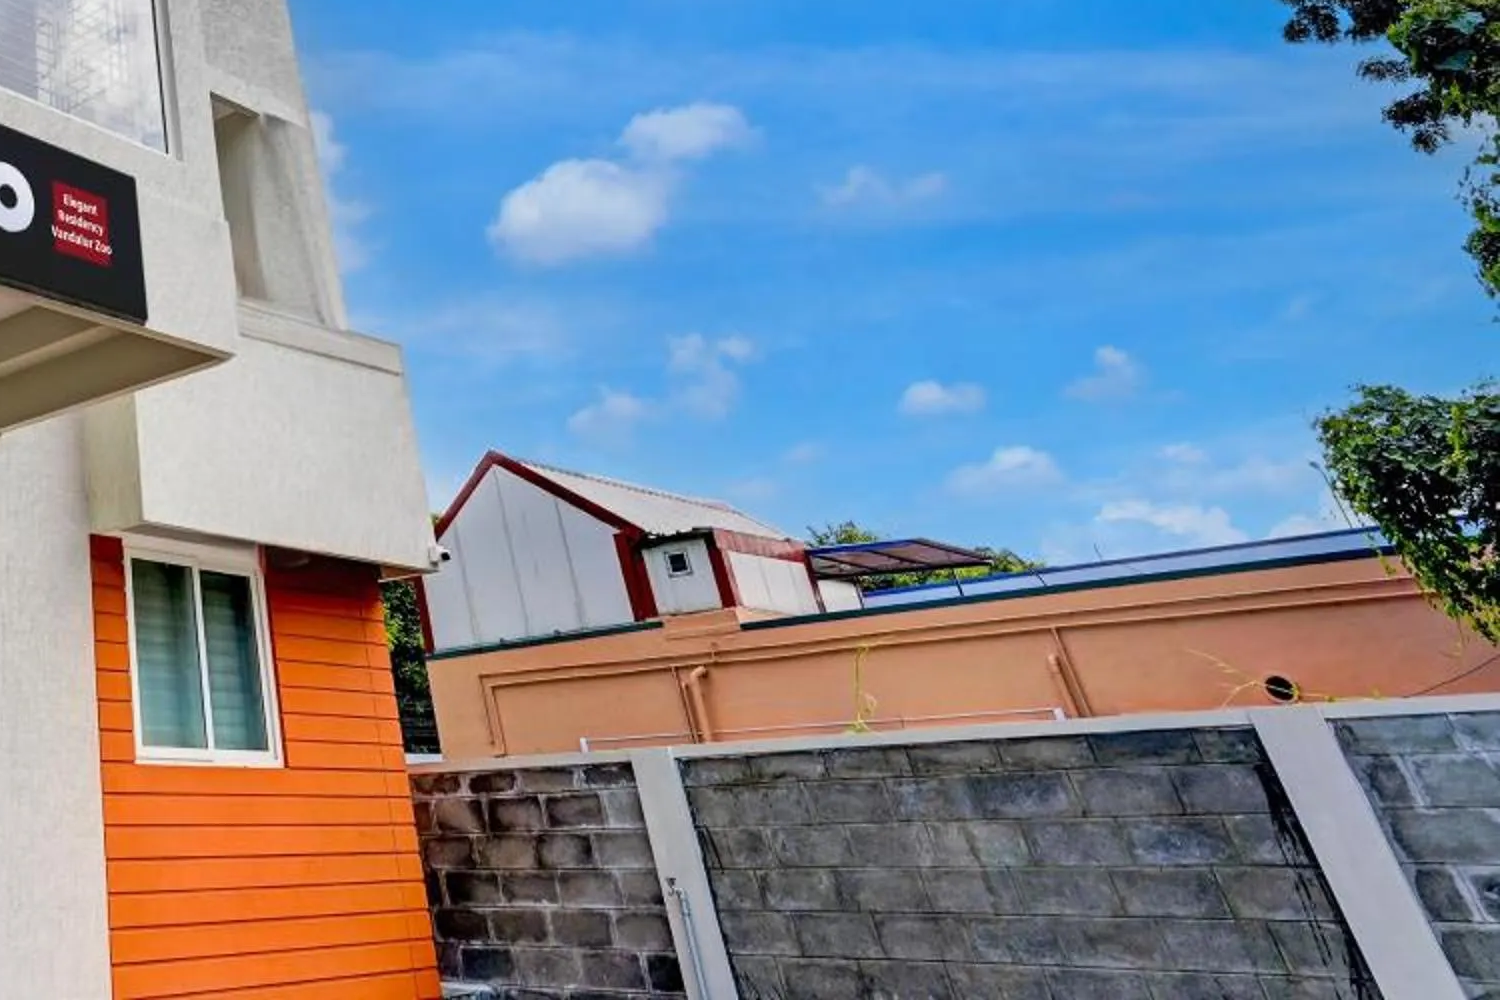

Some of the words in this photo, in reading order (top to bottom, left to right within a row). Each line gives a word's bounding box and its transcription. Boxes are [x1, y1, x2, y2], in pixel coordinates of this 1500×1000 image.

[63, 193, 98, 216] Elegant
[57, 209, 103, 237] Residency
[95, 240, 113, 255] Zoo
